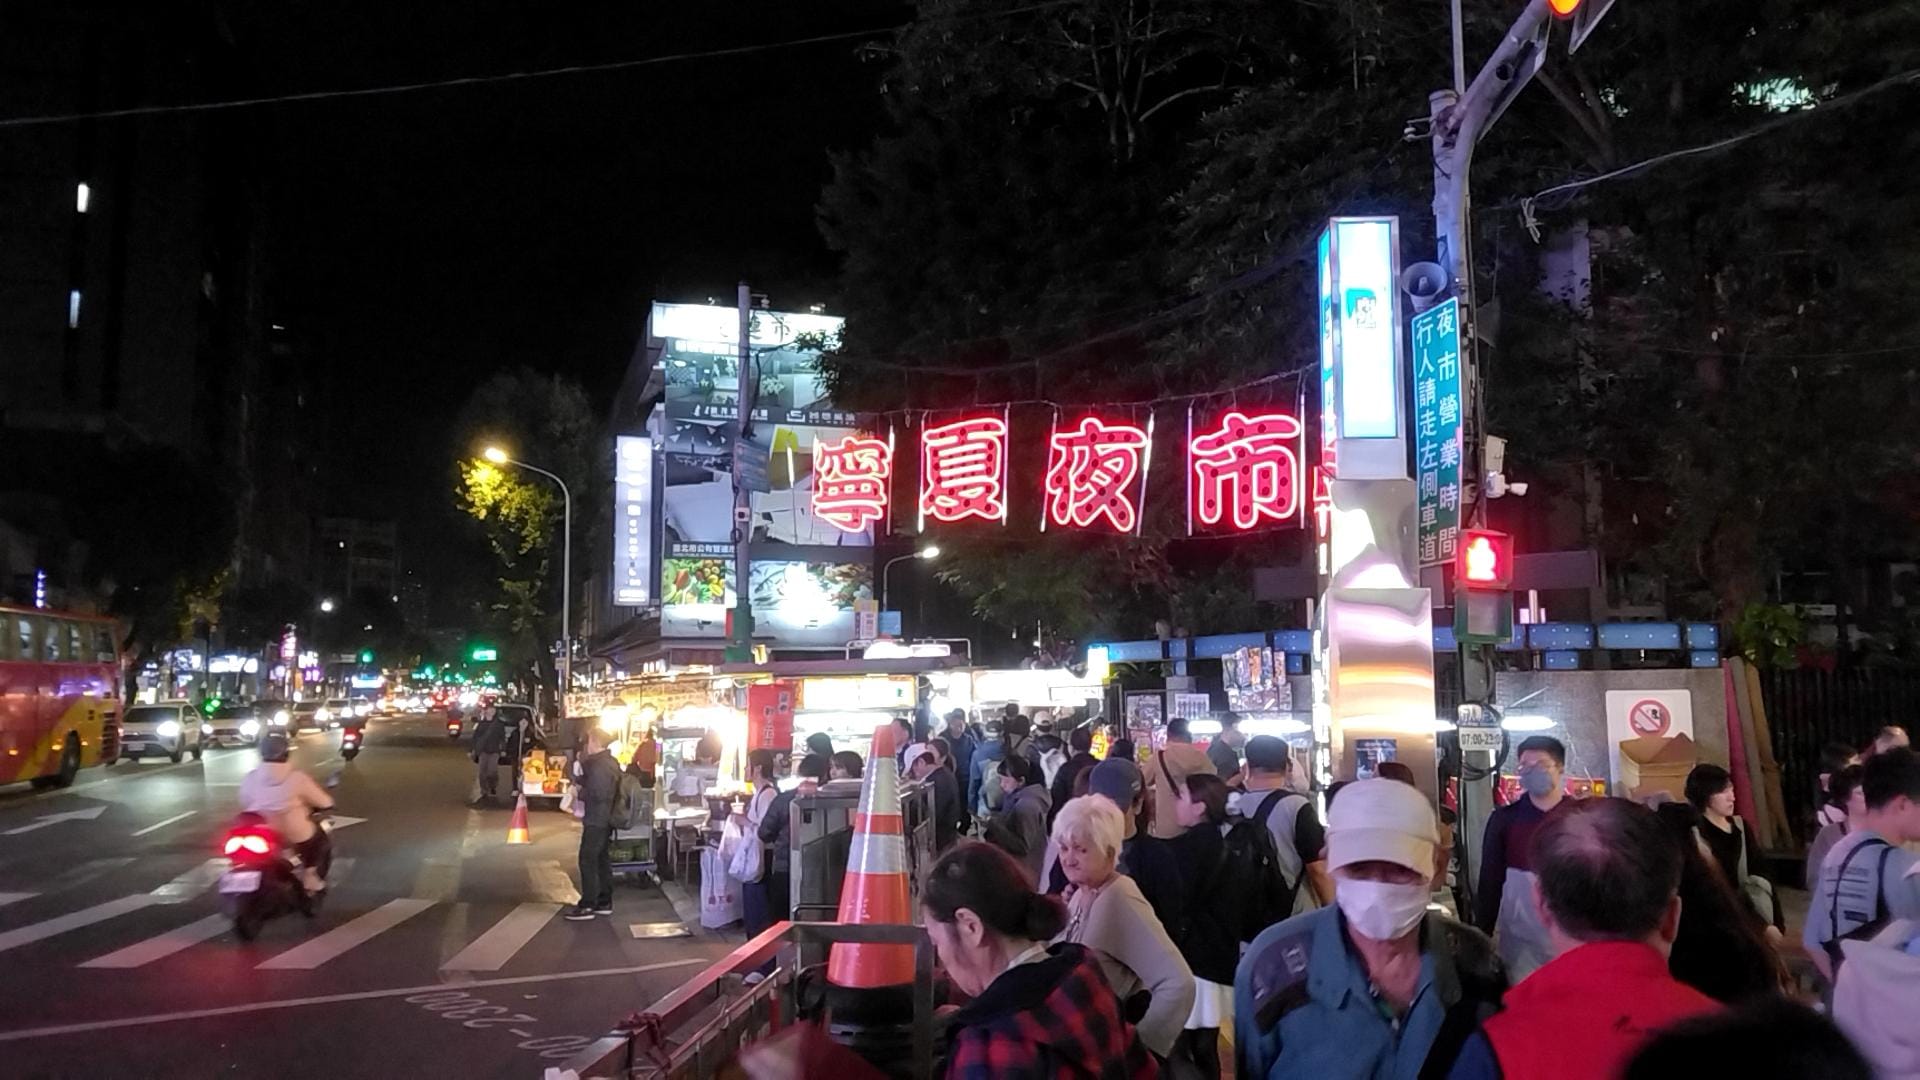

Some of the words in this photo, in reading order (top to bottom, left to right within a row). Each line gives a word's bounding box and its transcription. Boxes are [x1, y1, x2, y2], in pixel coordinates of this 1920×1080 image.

[813, 412, 1302, 533] 寧夏夜市
[1416, 317, 1438, 563] 行人請走左側車道
[1436, 306, 1458, 560] 夜市營業時間
